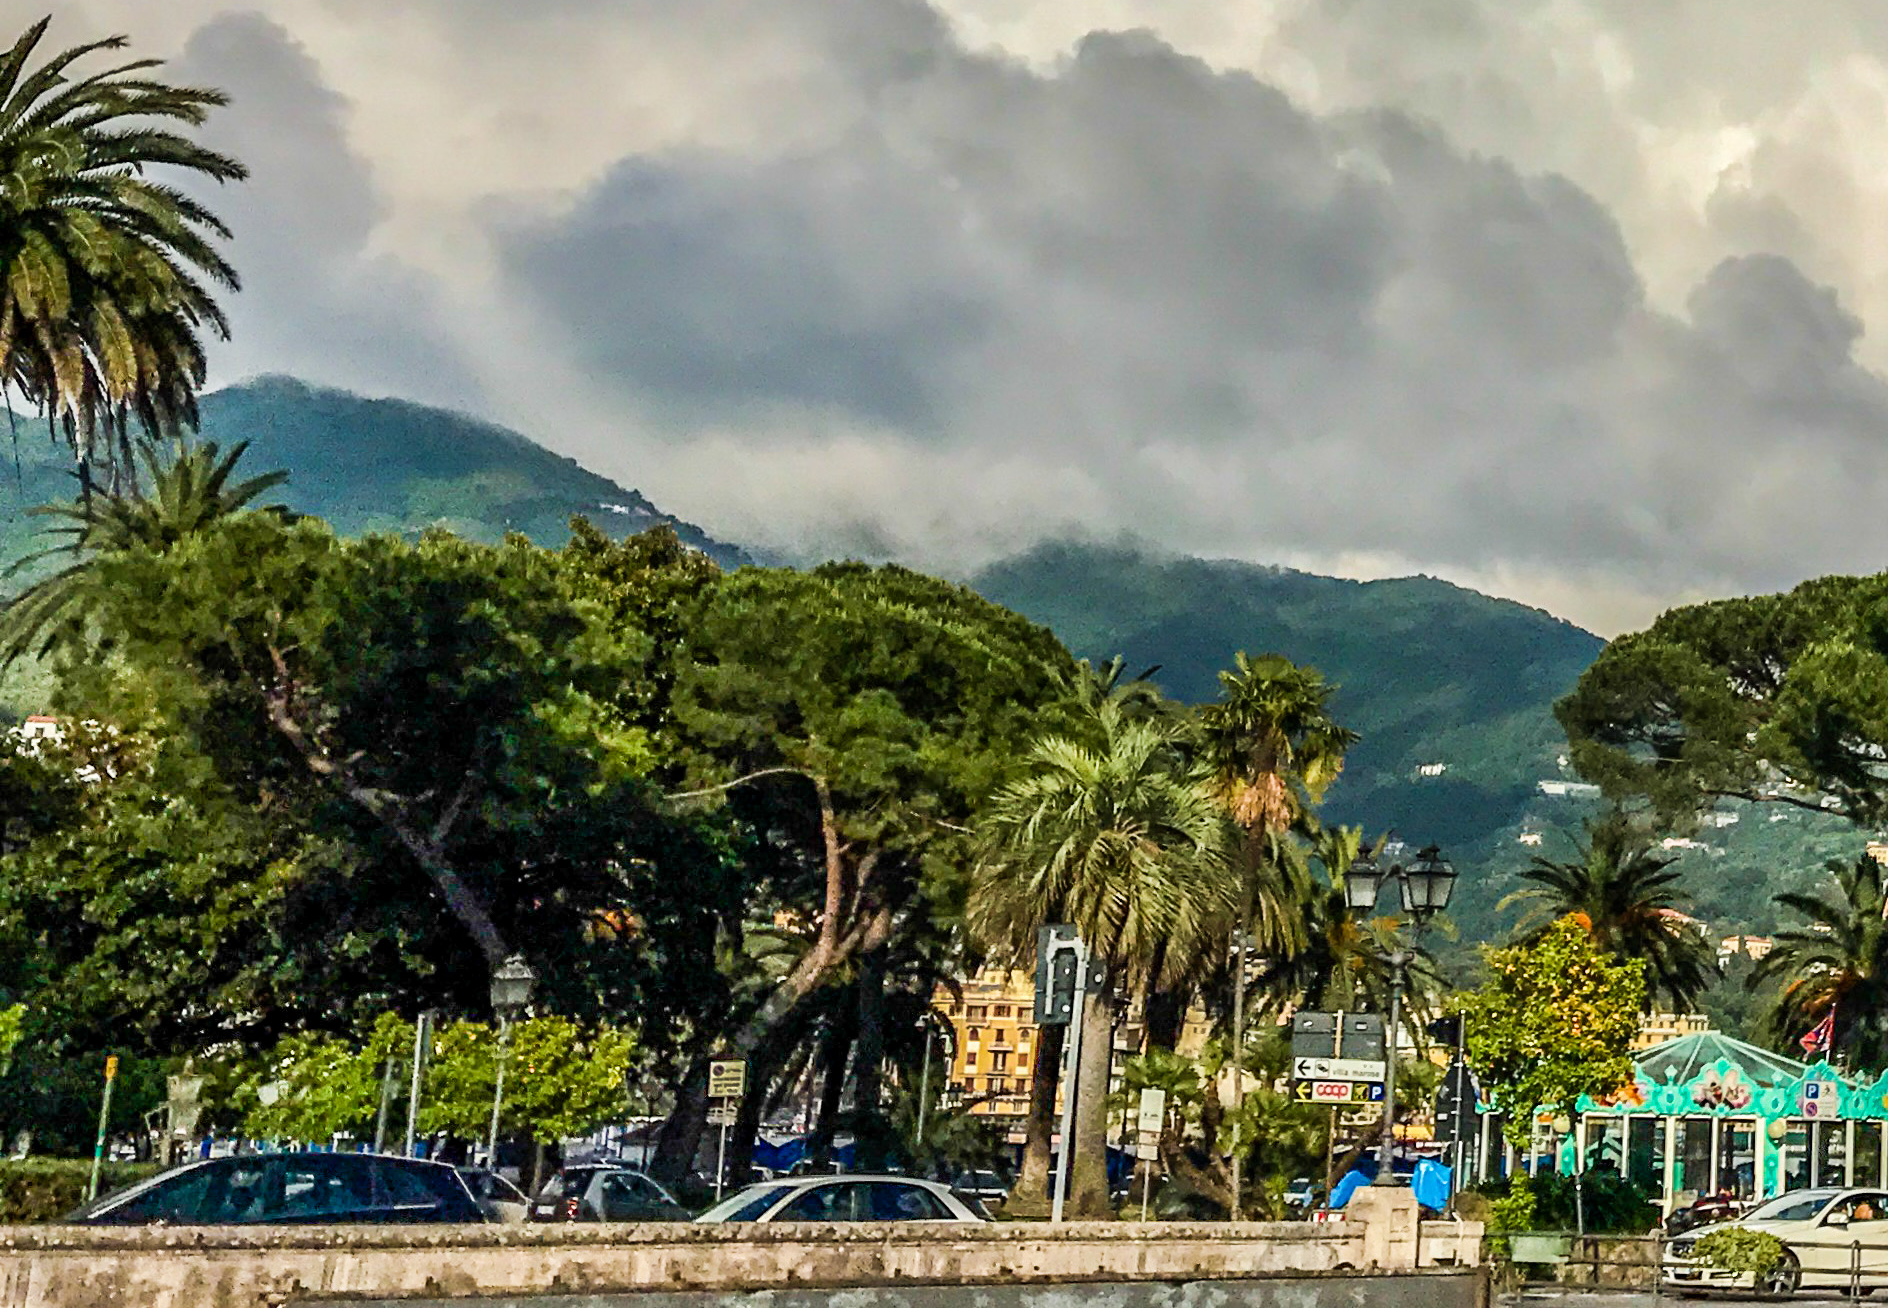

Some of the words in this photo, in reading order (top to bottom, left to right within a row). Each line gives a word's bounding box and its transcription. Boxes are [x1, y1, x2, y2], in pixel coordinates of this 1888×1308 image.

[1317, 1084, 1348, 1099] coop
[1372, 1086, 1382, 1099] P
[1808, 1085, 1817, 1097] P
